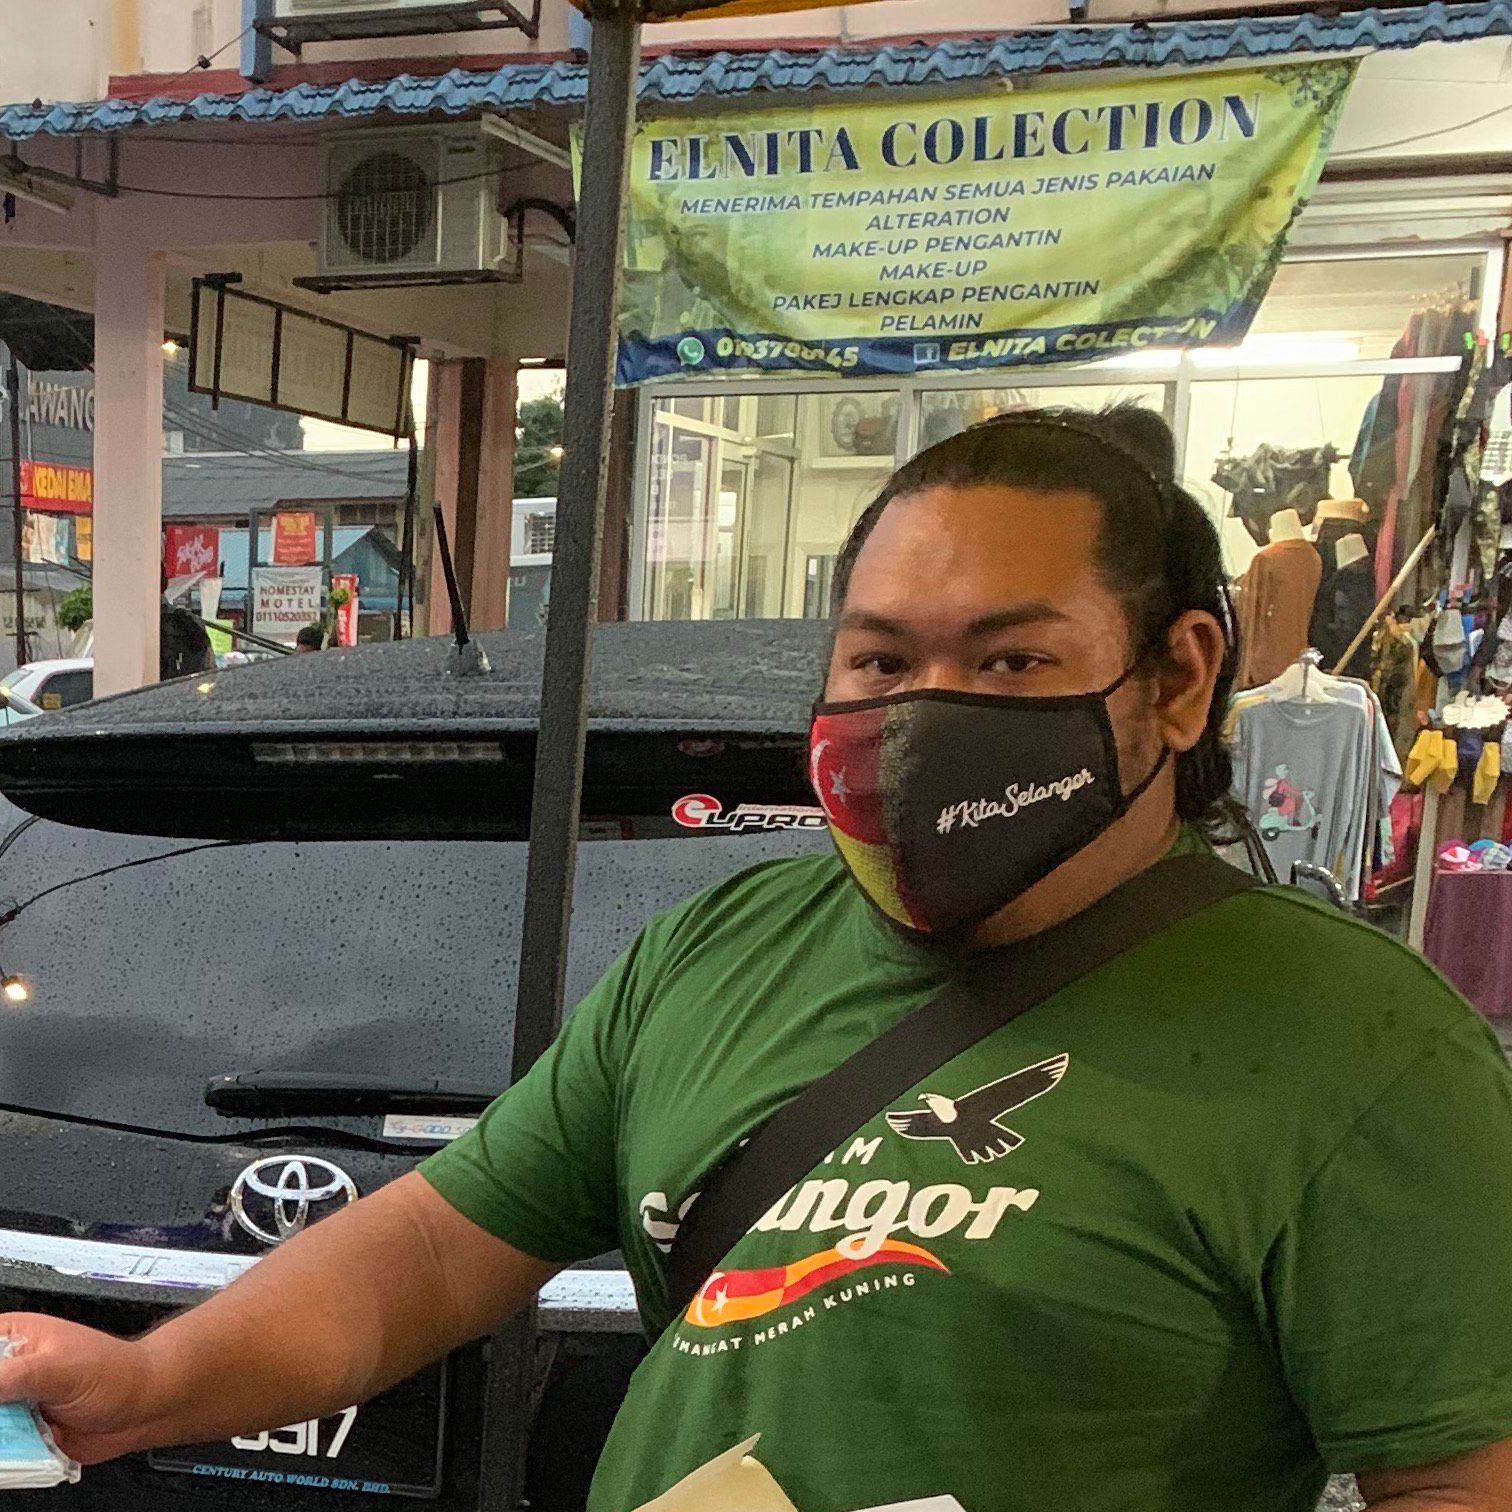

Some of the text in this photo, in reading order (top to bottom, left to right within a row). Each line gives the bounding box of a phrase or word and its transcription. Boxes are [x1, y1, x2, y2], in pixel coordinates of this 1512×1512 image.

[648, 92, 1260, 182] ELNITA COLECTION
[680, 163, 1217, 215] MENERIMA TEMPAHAN SEMUA JENIS PAKAIAN
[864, 207, 1011, 231] ALTERATION
[812, 228, 1062, 258] MAKE-UP PENGANTIN
[879, 260, 988, 281] MAKE-UP
[772, 280, 1100, 312] PAKEJ LENGKAP PENGANTIN
[880, 313, 983, 331] PELAMIN
[947, 335, 1046, 361] ELNITA
[754, 1307, 816, 1345] MERAH
[823, 1273, 916, 1309] KUNING
[192, 1464, 249, 1479] CENTURY
[249, 1470, 284, 1483] AUTO
[286, 1474, 330, 1488] WORLD
